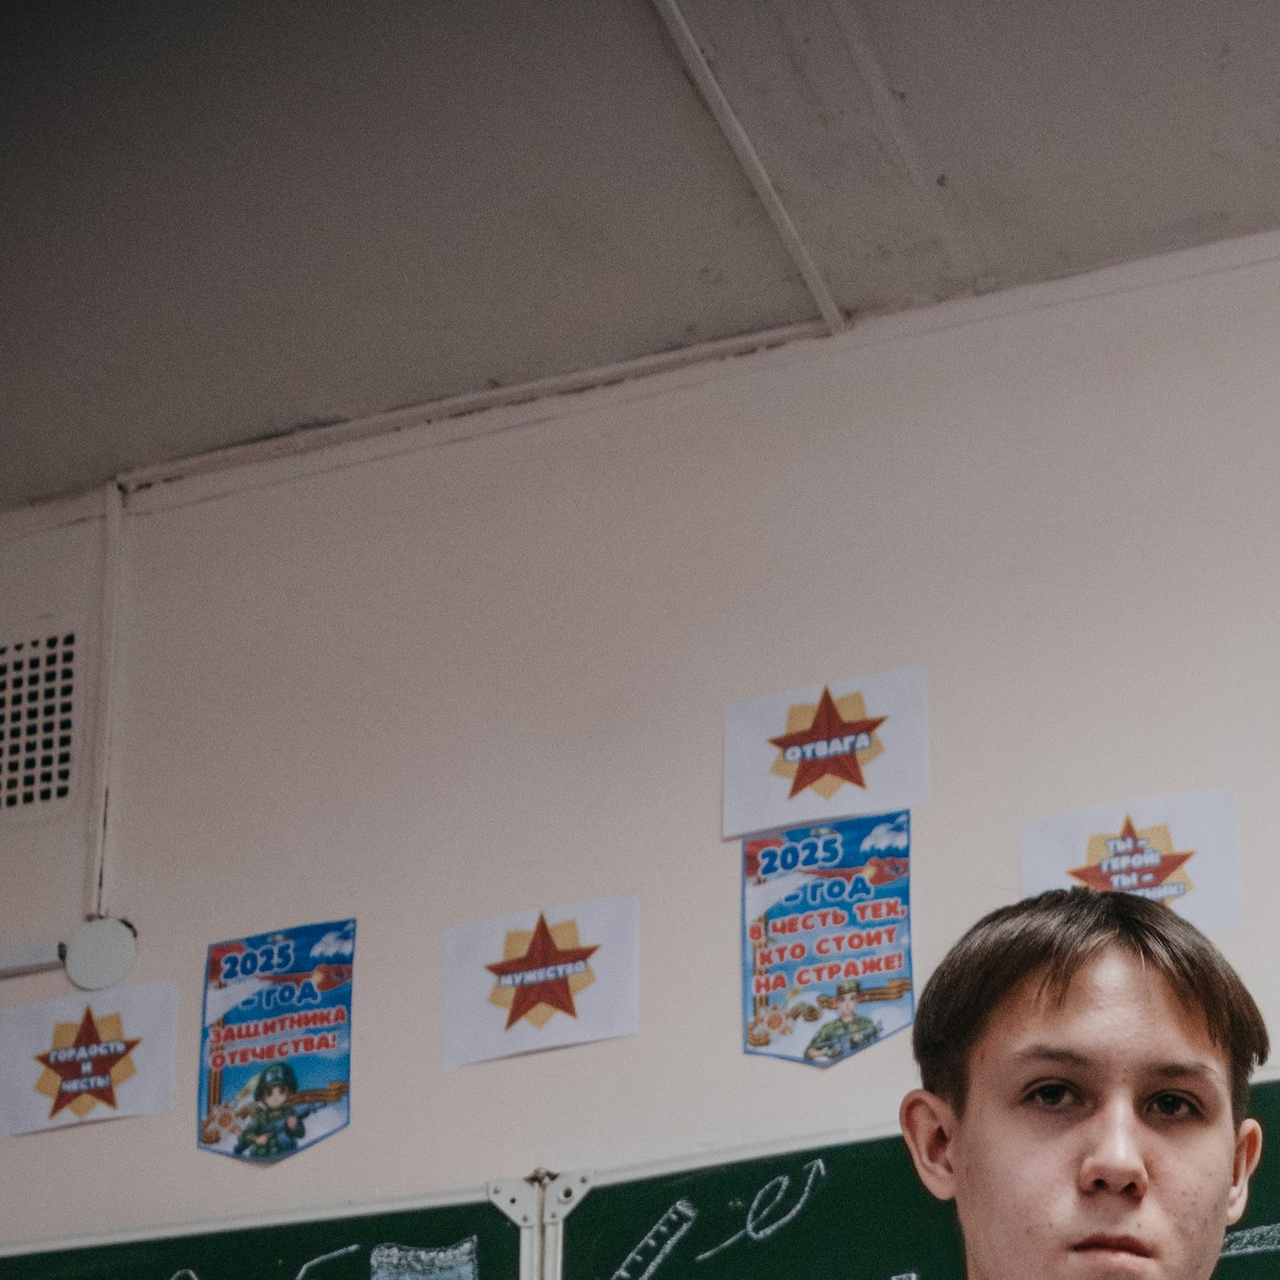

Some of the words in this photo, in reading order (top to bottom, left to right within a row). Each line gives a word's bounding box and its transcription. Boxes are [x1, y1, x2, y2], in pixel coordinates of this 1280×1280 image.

[783, 733, 871, 760] ОТВАГА
[761, 842, 840, 874] 2025
[808, 874, 873, 900] ГОД
[750, 923, 763, 941] В
[771, 910, 846, 935] ЧЕСТЬ
[856, 900, 906, 922] ТЕХ,
[222, 945, 293, 979] 2025
[759, 944, 806, 967] КТО
[815, 926, 898, 953] СТОИТ
[499, 960, 586, 987] МУЖЕСТВО
[753, 973, 788, 994] НА
[796, 953, 904, 985] СТРАЖЕ!
[260, 979, 321, 1010] ГОД
[210, 1005, 347, 1045] ЗАЩИТНИКА
[49, 1040, 126, 1063] ГОРДОСТЬ
[81, 1061, 93, 1073] И
[210, 1034, 337, 1069] ОТЕЧЕСТВА!
[61, 1076, 111, 1092] ЧЕСТЬ!
